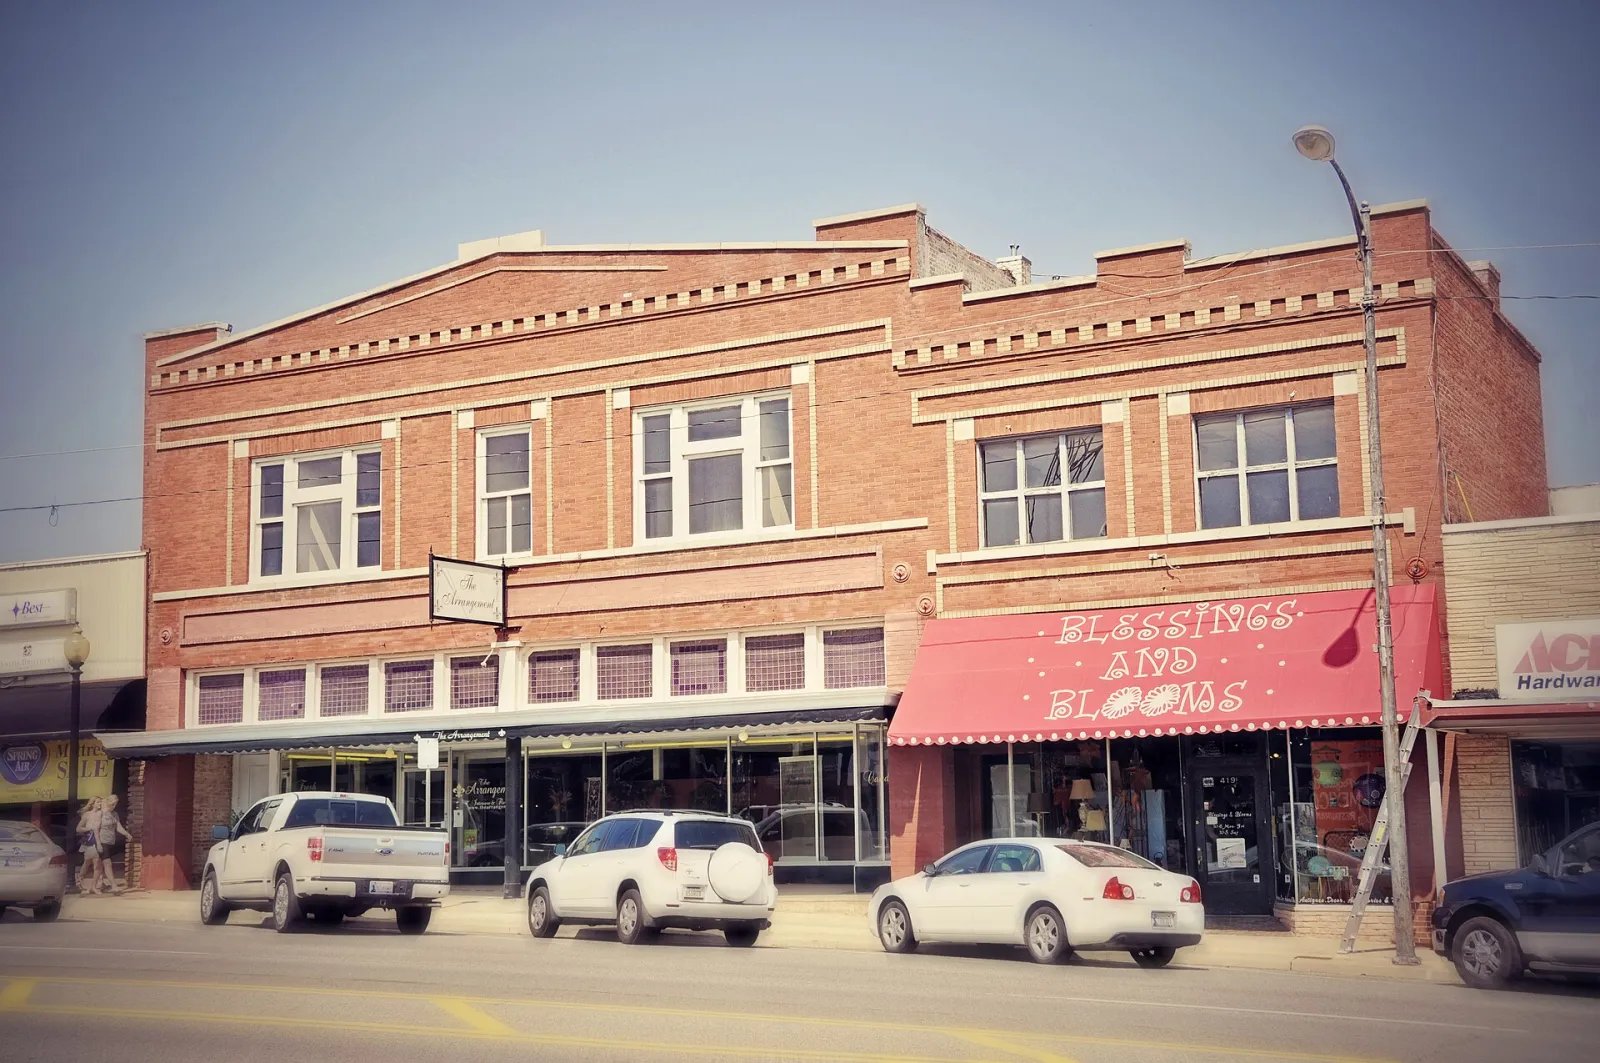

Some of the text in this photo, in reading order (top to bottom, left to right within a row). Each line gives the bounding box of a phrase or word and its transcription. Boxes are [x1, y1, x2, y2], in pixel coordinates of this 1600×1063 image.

[460, 574, 477, 592] The
[21, 601, 43, 614] Best
[442, 590, 495, 613] Arrangement
[1054, 599, 1297, 645] BLESSINGS
[1099, 647, 1197, 680] AND
[1044, 680, 1248, 721] BLOOMS
[432, 730, 490, 741] The Arrangement
[7, 749, 38, 761] SPRING
[15, 761, 30, 772] AIR
[57, 760, 108, 780] SLE
